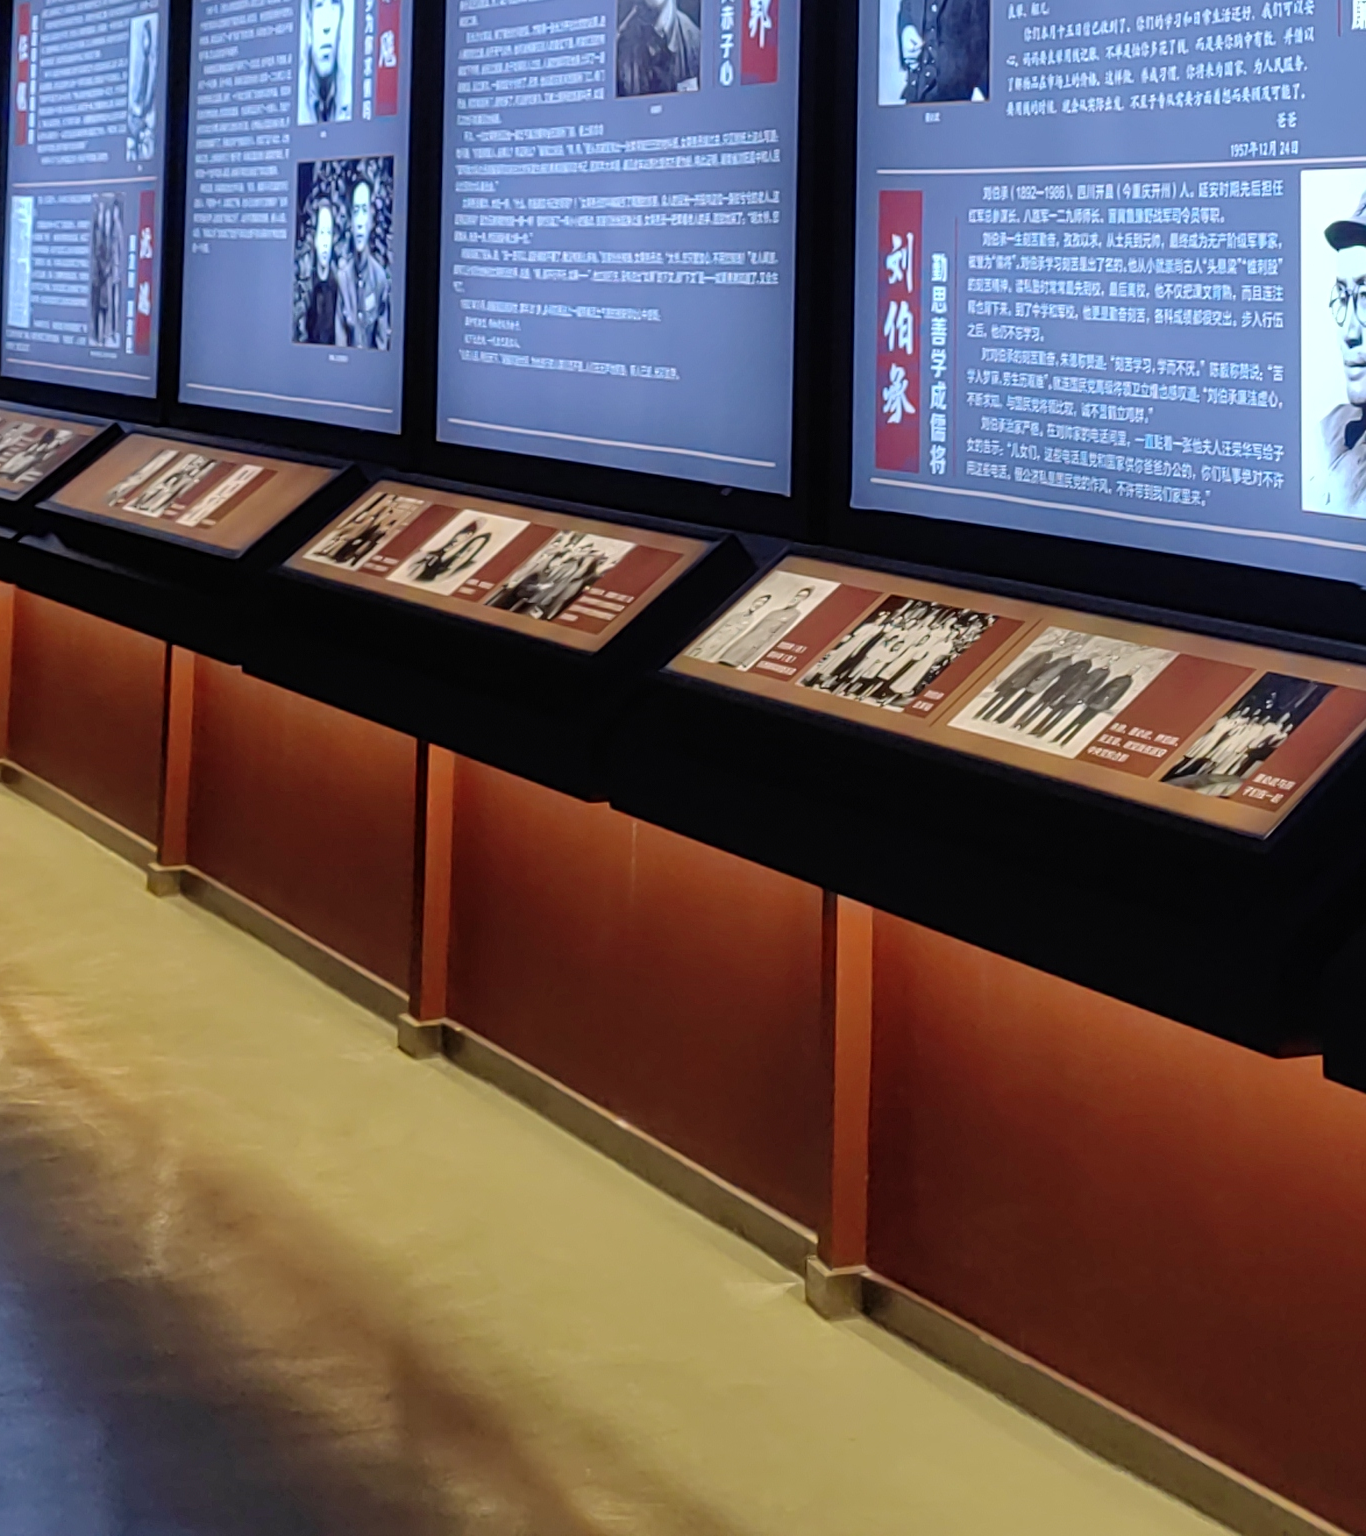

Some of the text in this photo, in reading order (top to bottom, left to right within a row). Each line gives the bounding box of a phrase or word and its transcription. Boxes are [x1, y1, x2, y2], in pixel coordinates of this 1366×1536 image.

[1276, 111, 1298, 129] 爸爸
[880, 231, 916, 427] 刘伯承
[929, 253, 948, 476] 勤思善学成儒将
